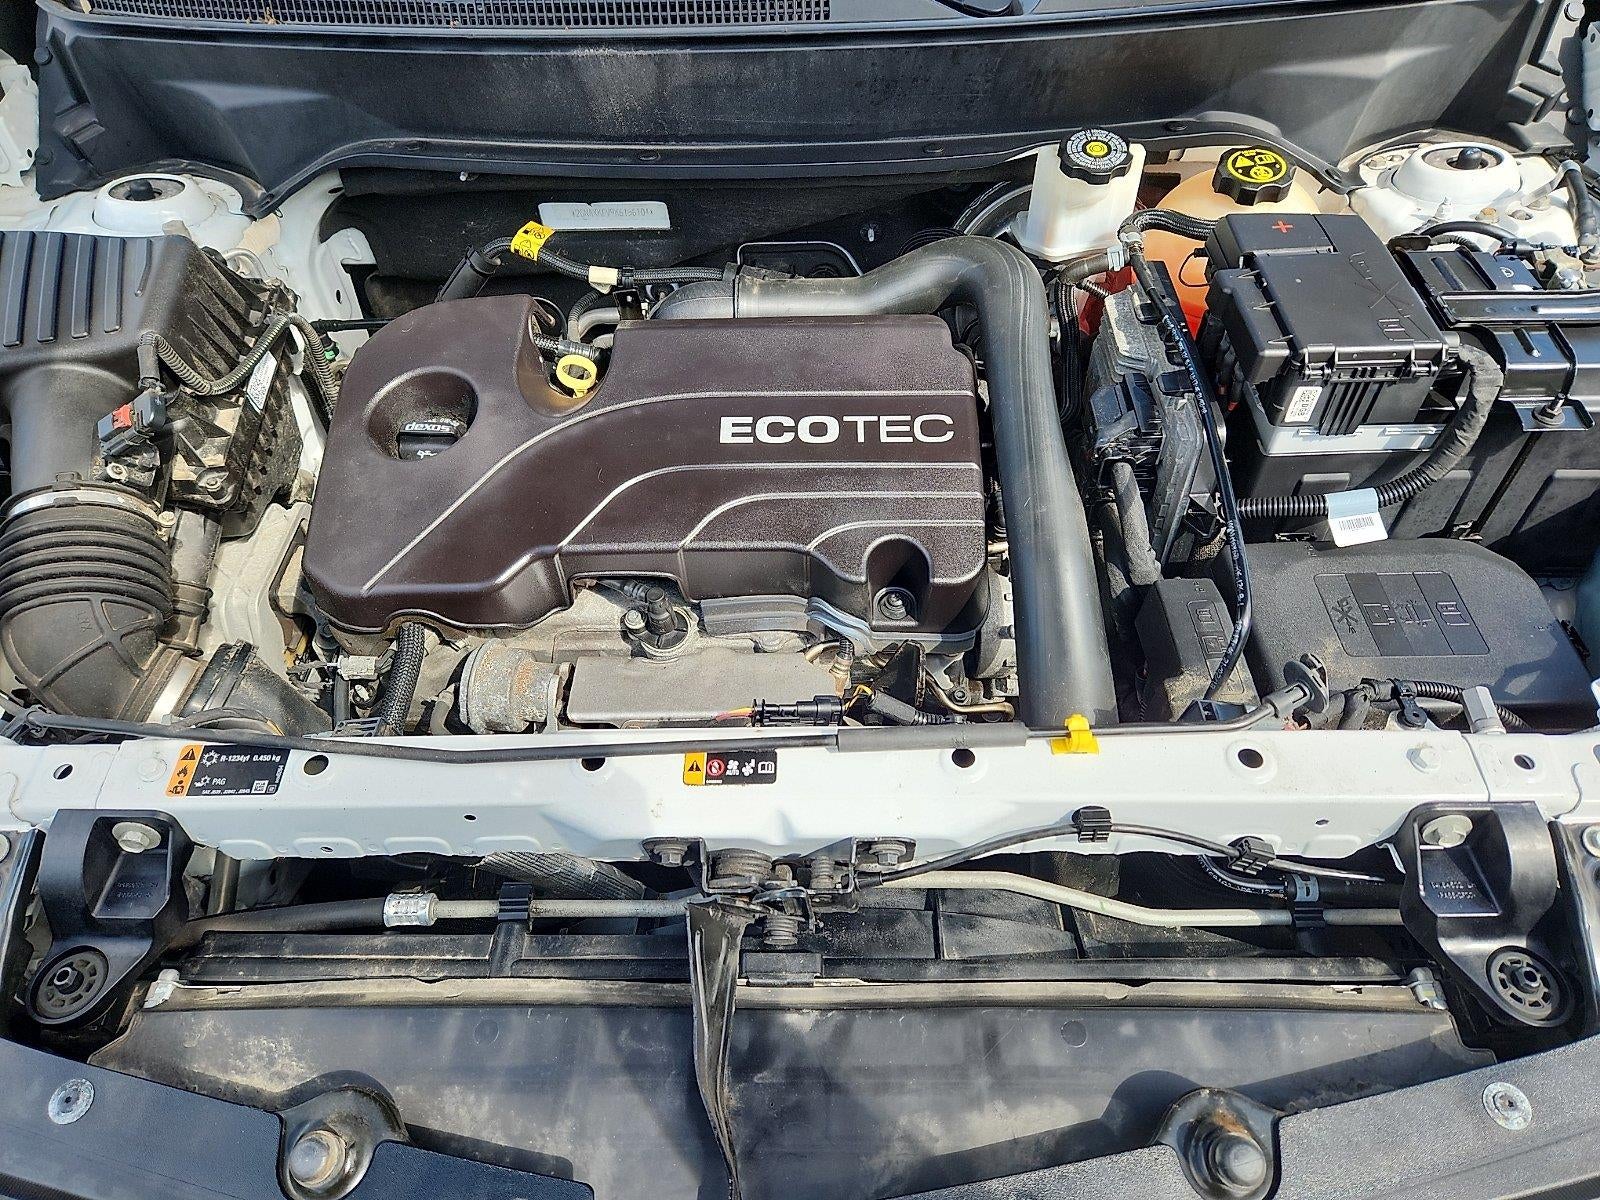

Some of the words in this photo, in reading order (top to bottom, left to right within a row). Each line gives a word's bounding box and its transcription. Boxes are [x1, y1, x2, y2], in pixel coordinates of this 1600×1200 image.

[405, 422, 450, 431] dexos
[719, 414, 955, 445] ECOTEC
[220, 755, 250, 764] R-1234yf
[272, 755, 281, 763] kg
